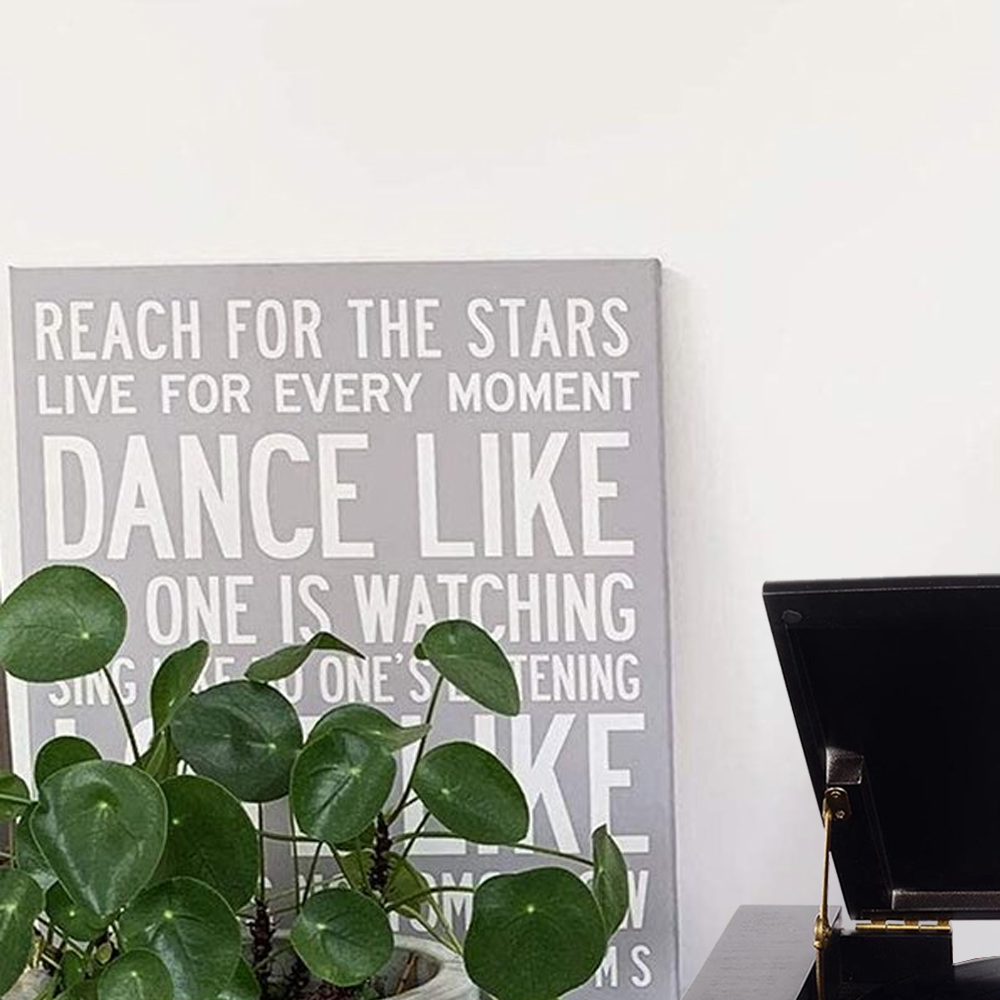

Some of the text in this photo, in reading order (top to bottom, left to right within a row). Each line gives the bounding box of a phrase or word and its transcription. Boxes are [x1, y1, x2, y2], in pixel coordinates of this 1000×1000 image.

[34, 297, 629, 360] REACH FOR THE STARS
[36, 370, 640, 415] LIVE FOR EVERY MOMENT
[42, 431, 634, 560] DANCE LIKE
[145, 572, 636, 645] ONE IS WATCHING
